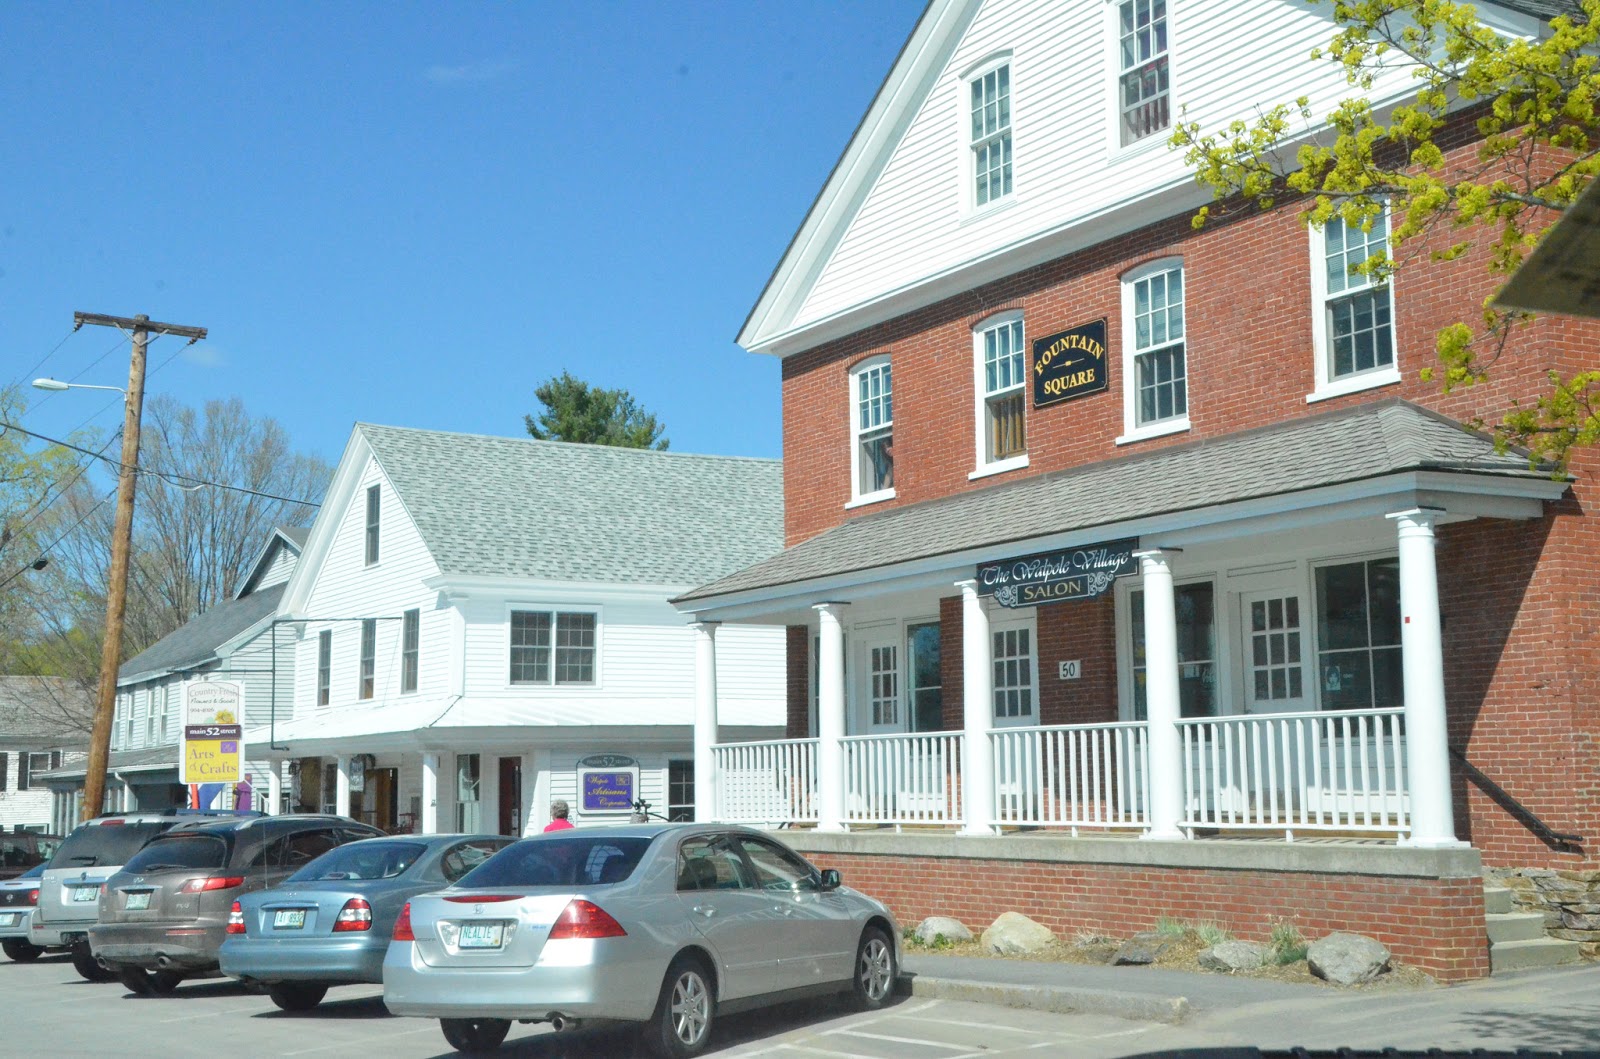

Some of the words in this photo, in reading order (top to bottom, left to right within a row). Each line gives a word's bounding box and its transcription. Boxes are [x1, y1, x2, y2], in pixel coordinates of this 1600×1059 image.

[1034, 334, 1104, 376] FOUNTAIN
[1043, 368, 1095, 395] SQUARE
[981, 565, 1009, 585] The
[1012, 555, 1070, 583] Walpole
[1073, 549, 1129, 573] Village
[1024, 580, 1081, 600] SALON
[1062, 662, 1076, 678] 50
[190, 688, 217, 697] Country
[206, 727, 220, 736] 52
[190, 748, 214, 760] Arts
[200, 761, 237, 774] Crafts
[602, 756, 615, 767] 52
[588, 786, 627, 796] Artisans
